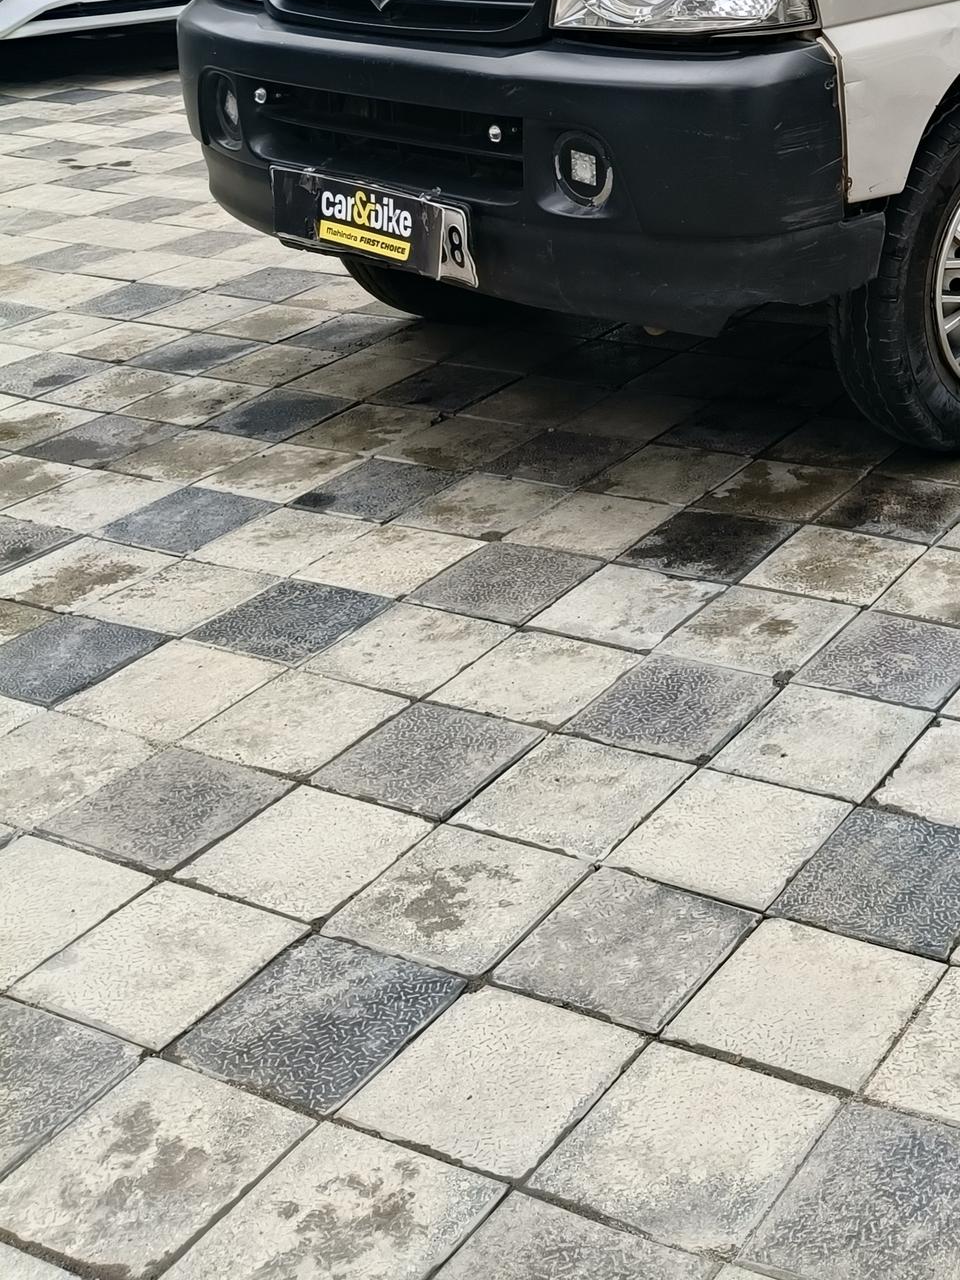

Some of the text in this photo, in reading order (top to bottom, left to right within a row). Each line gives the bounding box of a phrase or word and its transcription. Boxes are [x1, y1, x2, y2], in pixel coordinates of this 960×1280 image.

[321, 190, 412, 237] car&bike
[326, 226, 406, 255] Mahindra FIRST CHOICE
